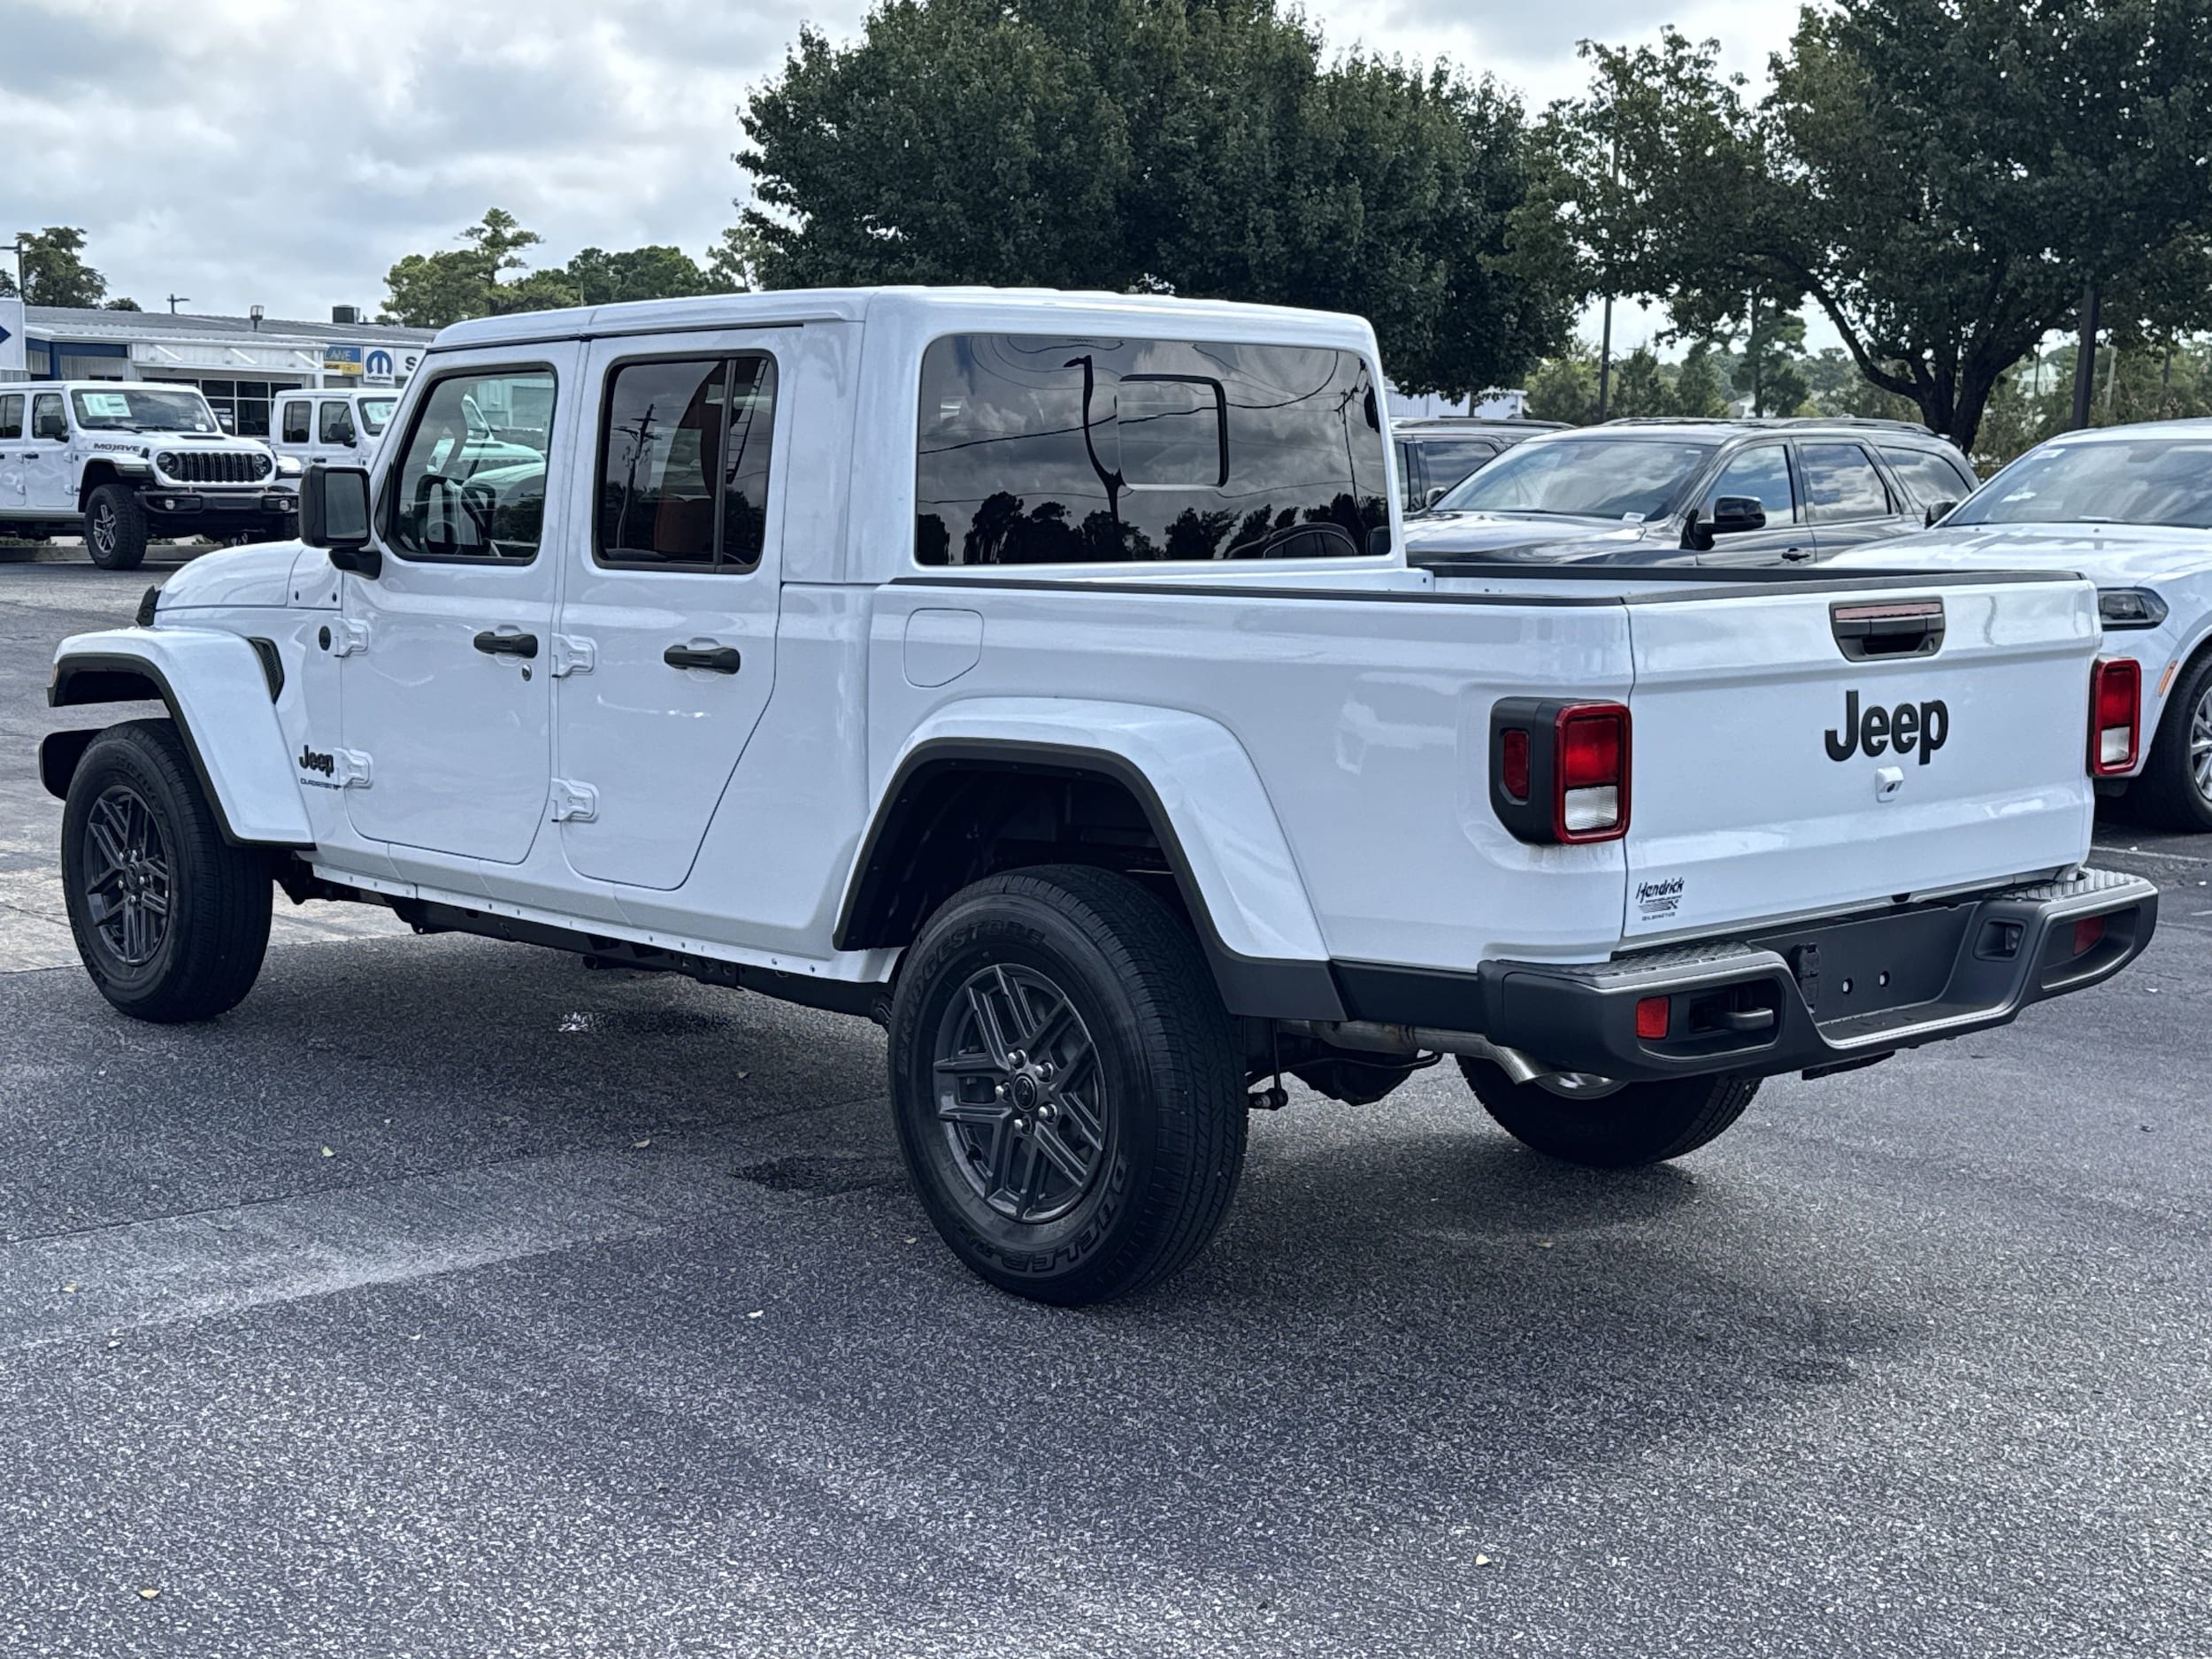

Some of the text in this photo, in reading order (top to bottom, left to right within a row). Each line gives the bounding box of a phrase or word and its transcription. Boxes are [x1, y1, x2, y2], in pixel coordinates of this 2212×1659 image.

[93, 442, 141, 452] MOJAVE
[1824, 689, 1949, 765] Jeep
[299, 744, 334, 779] Jeep
[1635, 877, 1685, 903] Hendrick
